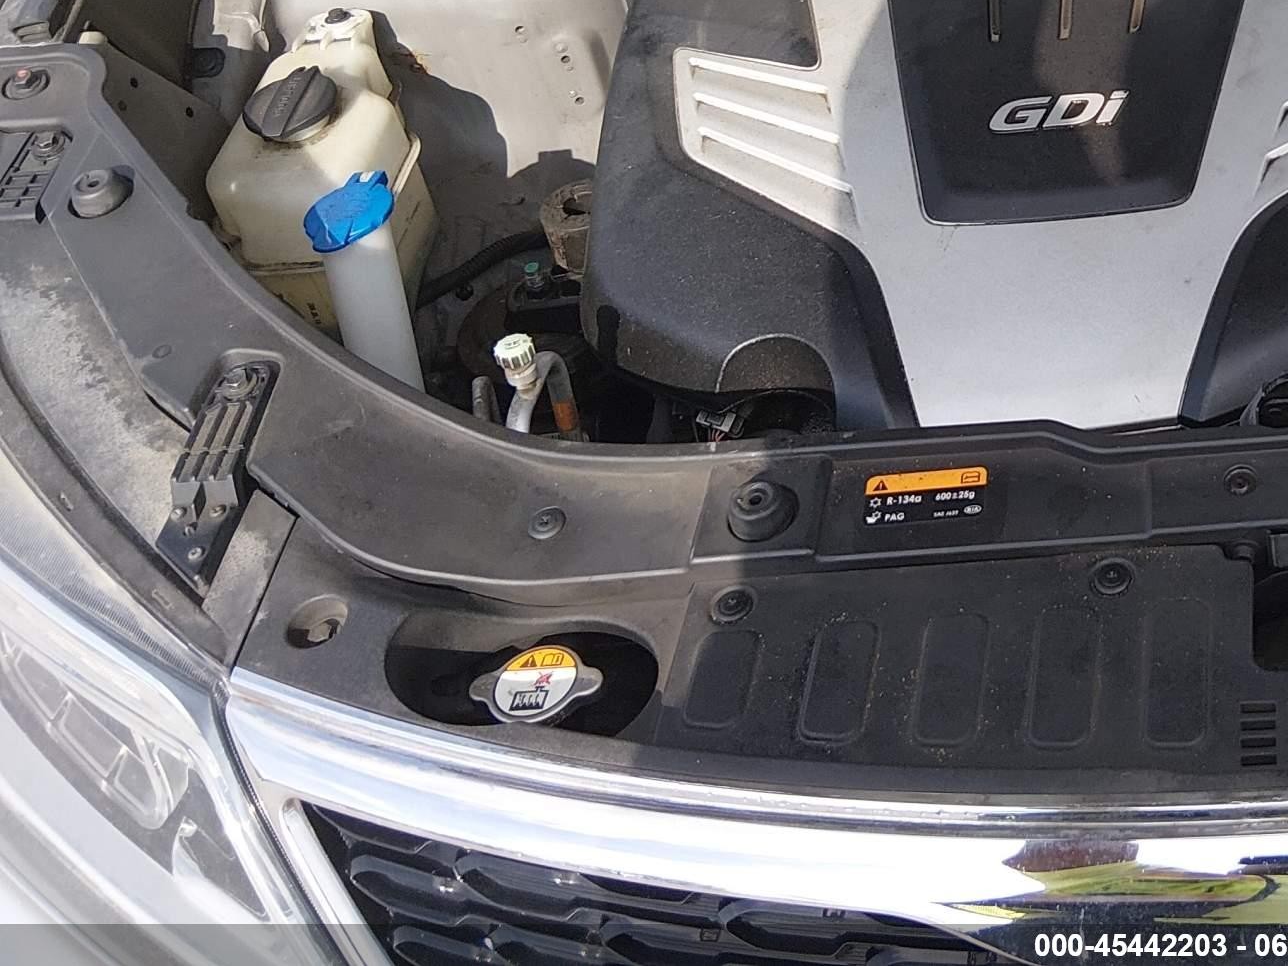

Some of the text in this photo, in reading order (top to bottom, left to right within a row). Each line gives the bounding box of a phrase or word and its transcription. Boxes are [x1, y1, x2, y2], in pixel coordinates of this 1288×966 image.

[989, 89, 1130, 132] GDi
[886, 490, 976, 506] R-134a 600±25g
[884, 512, 905, 522] PAG
